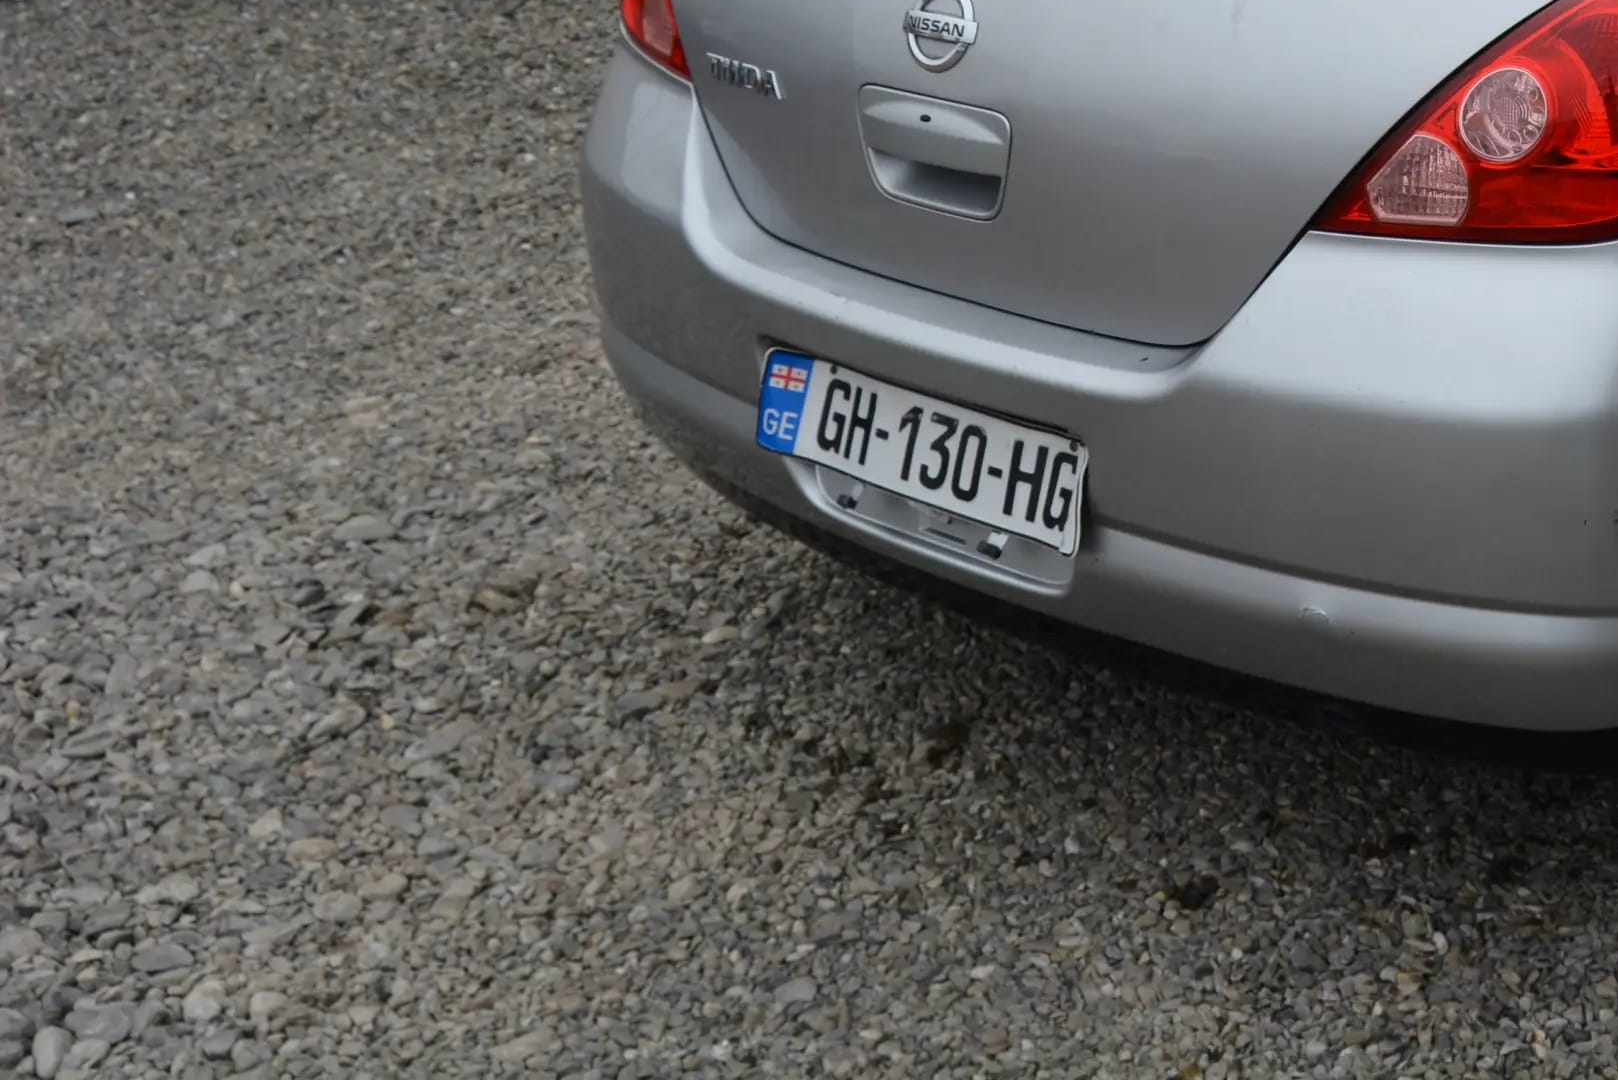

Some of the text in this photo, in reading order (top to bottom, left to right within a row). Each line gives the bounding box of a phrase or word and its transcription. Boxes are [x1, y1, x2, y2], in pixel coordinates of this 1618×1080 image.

[909, 15, 965, 38] NISSAN
[762, 407, 798, 441] GE
[816, 377, 1079, 532] GH-130-HG
